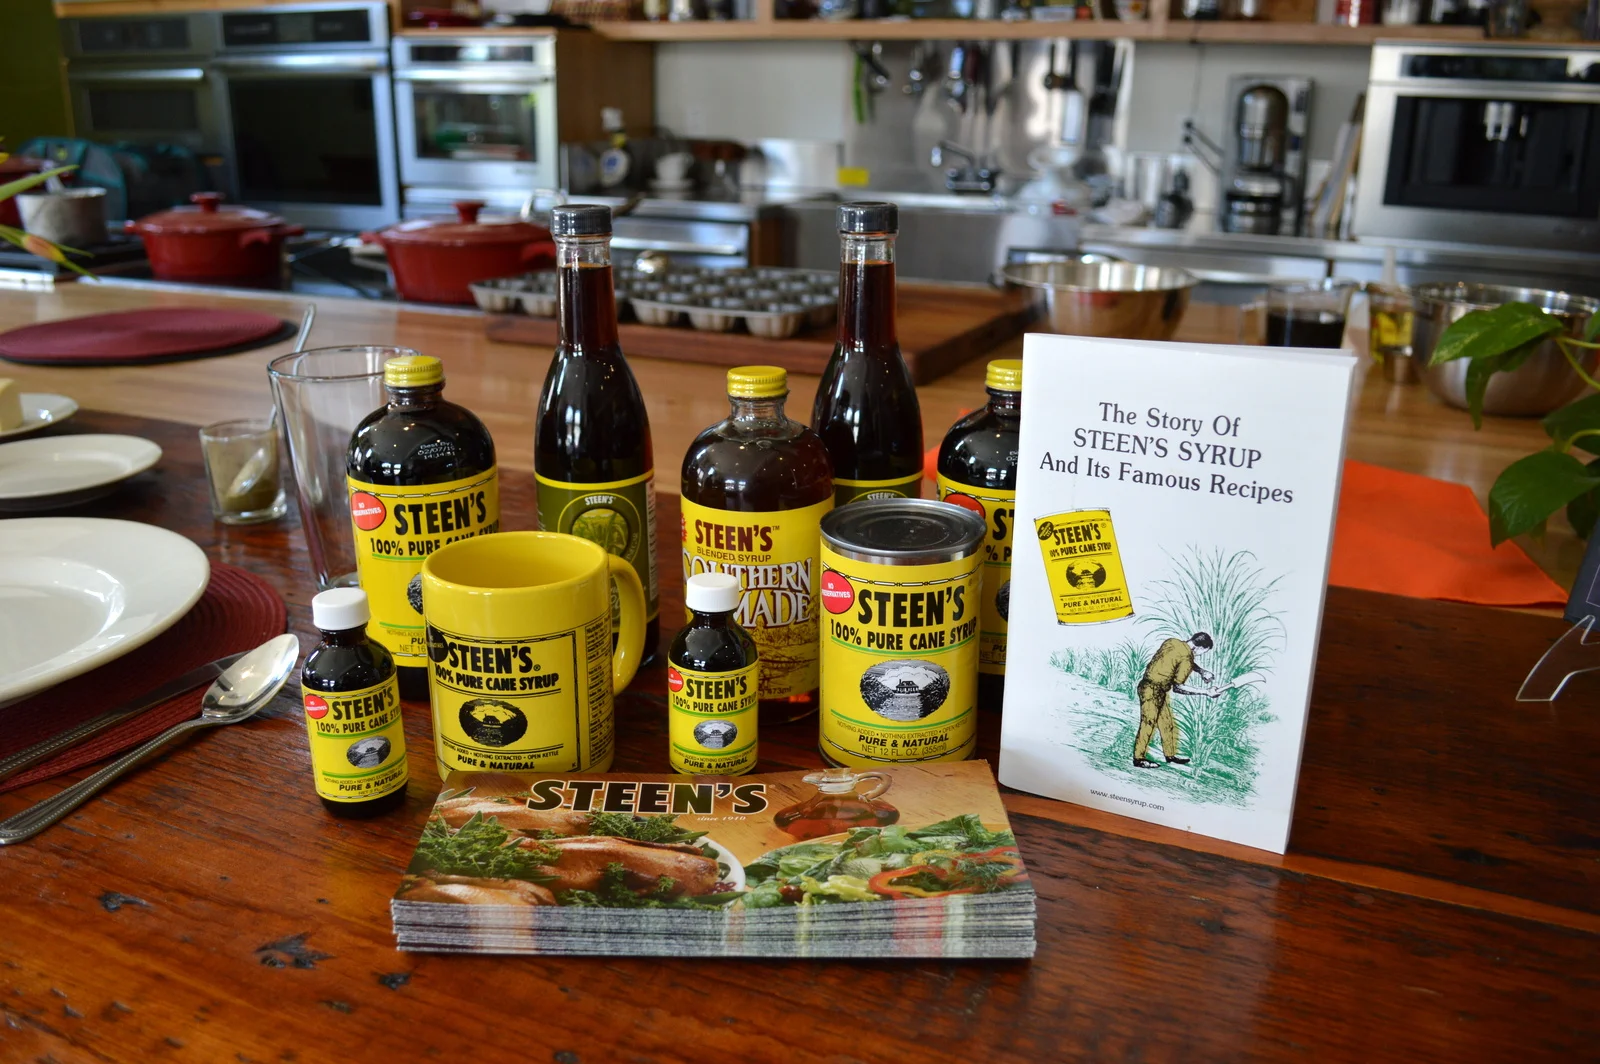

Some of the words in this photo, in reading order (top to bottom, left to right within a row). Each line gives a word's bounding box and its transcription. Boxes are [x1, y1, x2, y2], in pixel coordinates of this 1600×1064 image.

[1099, 401, 1137, 425] The
[1146, 407, 1203, 437] Story
[1212, 414, 1241, 438] Of
[1073, 427, 1168, 458] STEEN'S
[1178, 440, 1262, 469] SYRUP
[1039, 451, 1079, 475] And
[1086, 457, 1111, 479] Its
[1118, 462, 1201, 492] Famous
[1209, 474, 1294, 504] Recipes
[584, 496, 614, 506] STEEN'S
[393, 491, 487, 536] STEEN'S
[695, 519, 773, 552] STEEN'S
[1053, 522, 1102, 546] STEEN'S
[370, 537, 403, 556] 100%
[408, 540, 441, 556] PURE
[697, 546, 735, 561] BLENDED
[738, 554, 771, 562] SYRUP
[1060, 545, 1078, 556] PURE
[1079, 543, 1097, 553] CANE
[733, 589, 811, 629] MADE
[857, 585, 965, 628] STEEN'S
[1090, 595, 1123, 605] NATURAL
[831, 618, 862, 646] 100%
[867, 631, 903, 650] PURE
[910, 630, 945, 650] CANE
[949, 616, 977, 645] SYRUP
[400, 644, 413, 653] NET
[448, 641, 533, 674] STEEN'S
[456, 672, 483, 690] PURE
[486, 677, 517, 691] CANE
[519, 672, 559, 690] SYRUP
[686, 675, 747, 700] STEEN'S
[332, 686, 394, 721] STEEN'S
[672, 693, 690, 710] 100%
[693, 701, 714, 713] PURE
[717, 701, 738, 712] CANE
[316, 721, 339, 733] 100%
[342, 721, 366, 733] PURE
[369, 713, 389, 729] CANE
[837, 720, 856, 733] NOTHING
[857, 728, 875, 737] ADDED
[907, 729, 938, 739] EXTRACTED
[942, 725, 954, 734] OPEN
[858, 734, 888, 747] PURE
[890, 739, 899, 748] &
[902, 733, 950, 748] NATURAL
[861, 744, 877, 754] NET
[880, 746, 889, 756] 12
[906, 747, 920, 756] OZ.
[457, 754, 477, 766] PURE
[479, 760, 486, 768] &
[489, 761, 535, 770] NATURAL
[474, 752, 493, 760] NOTHING
[542, 750, 559, 758] KETTLE
[684, 758, 704, 768] PURE
[715, 757, 748, 769] NATURAL
[374, 769, 404, 787] NATURAL
[526, 779, 769, 815] STEEN'S
[1090, 788, 1164, 811] www.steensyrup.com
